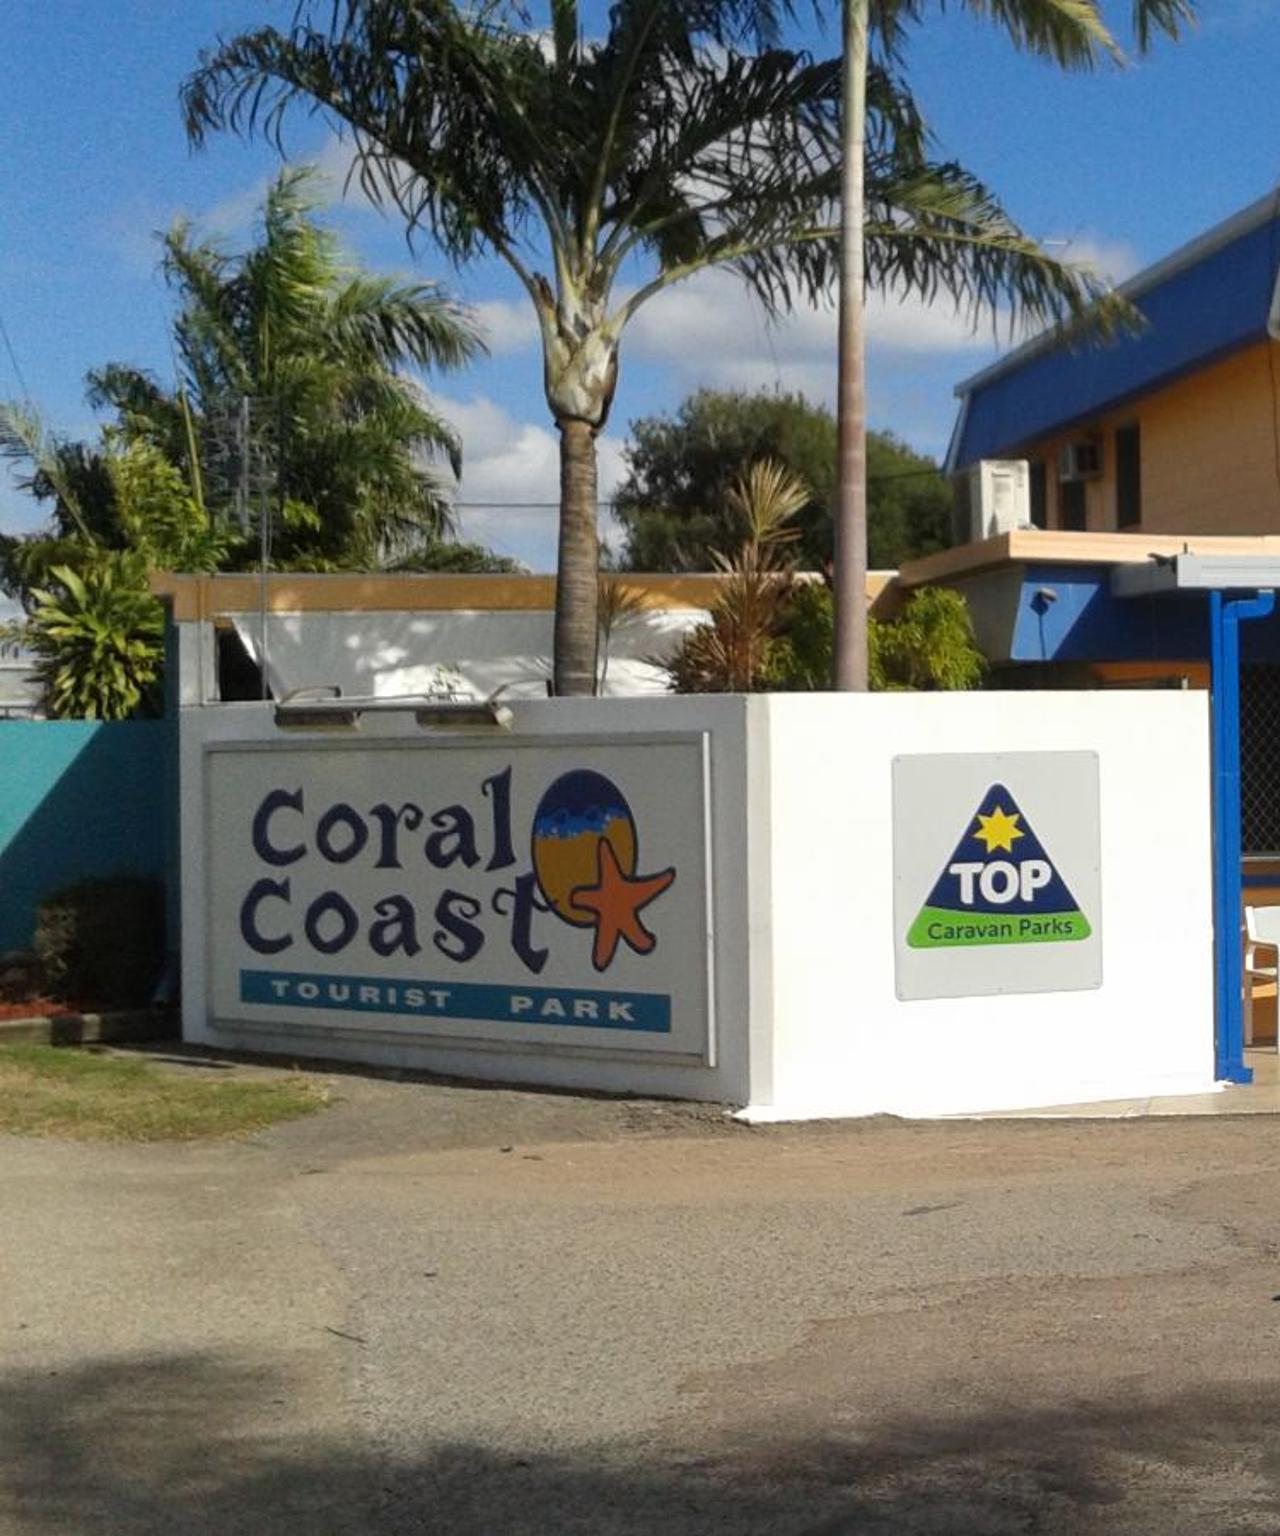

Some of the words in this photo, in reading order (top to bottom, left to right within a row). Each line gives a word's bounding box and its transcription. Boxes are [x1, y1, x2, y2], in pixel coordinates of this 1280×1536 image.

[251, 764, 517, 873] Coral
[949, 859, 1052, 904] TOP
[239, 873, 551, 975] Coast
[927, 921, 1013, 940] Caravan
[1019, 917, 1073, 936] Parks
[270, 978, 452, 1009] TOURIST
[510, 995, 636, 1022] PARK
